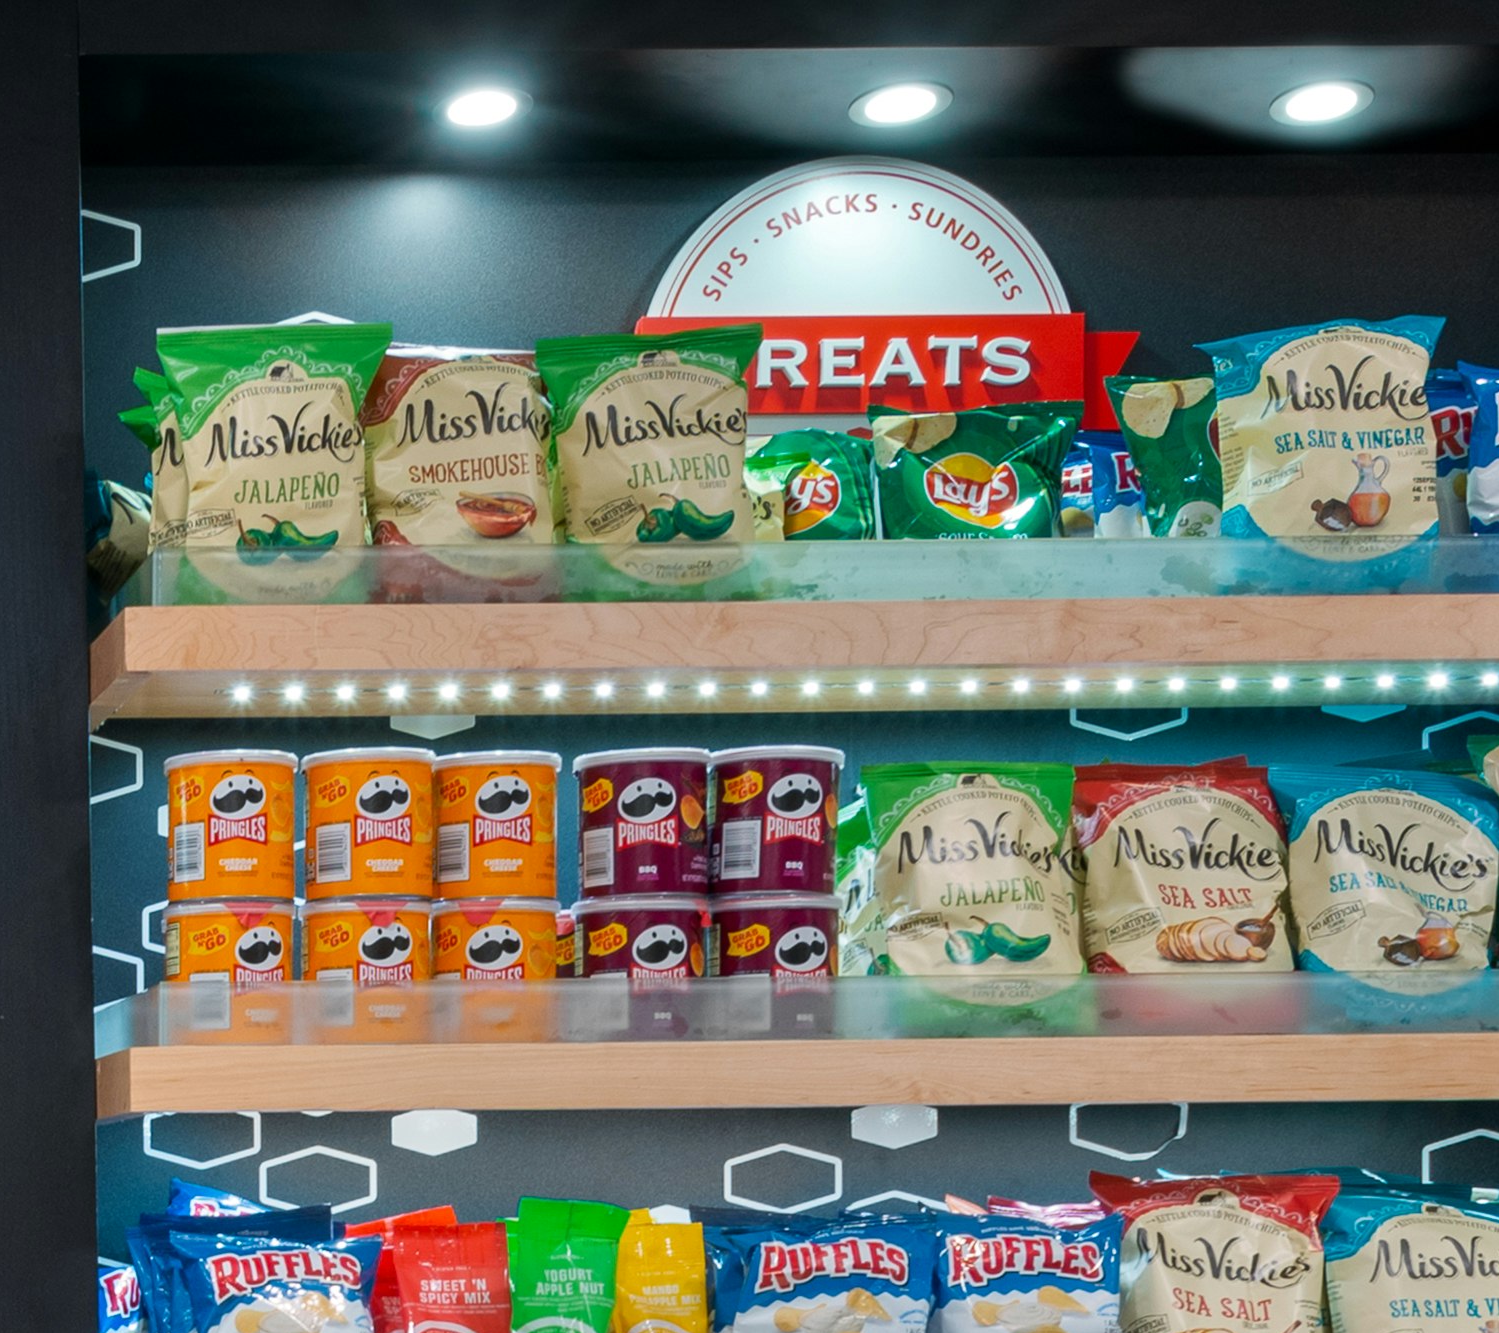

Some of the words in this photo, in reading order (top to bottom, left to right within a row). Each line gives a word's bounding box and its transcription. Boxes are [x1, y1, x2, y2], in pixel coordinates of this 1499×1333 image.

[703, 247, 748, 302] SIPS
[766, 193, 878, 238] SNACKS
[909, 202, 1022, 301] SUNDRIES
[755, 337, 1032, 388] REATS
[1275, 433, 1304, 454] SEA
[1308, 430, 1337, 449] SALT
[1356, 427, 1425, 450] VINEGAR
[409, 454, 530, 484] SMOKEHOUSE
[627, 453, 731, 489] JALAPEÑO
[234, 472, 340, 504] JALAPEÑO
[929, 463, 1013, 517] Lay's
[210, 818, 266, 843] PRINGLES
[356, 817, 411, 843] PRINGLES
[618, 822, 676, 847] PRINGLES
[766, 816, 820, 843] PRINGLES
[638, 866, 657, 874] BBQ
[1330, 873, 1361, 893] SEA
[940, 877, 1045, 907] JALAPEÑO
[1158, 884, 1192, 908] SEA
[1203, 888, 1252, 908] SALT
[759, 1238, 908, 1290] RUFFLES
[950, 1235, 1102, 1284] RUFFLES
[210, 1250, 361, 1299] RUFFLES
[420, 1280, 466, 1292] SWEET
[544, 1269, 593, 1282] YOGURT
[419, 1292, 458, 1304] SPICY
[464, 1291, 491, 1303] MIX
[536, 1282, 574, 1296] APPLE
[580, 1282, 604, 1296] NUT
[1172, 1287, 1208, 1315] SEA
[1220, 1299, 1272, 1322] SALT
[1423, 1300, 1459, 1317] SALT
